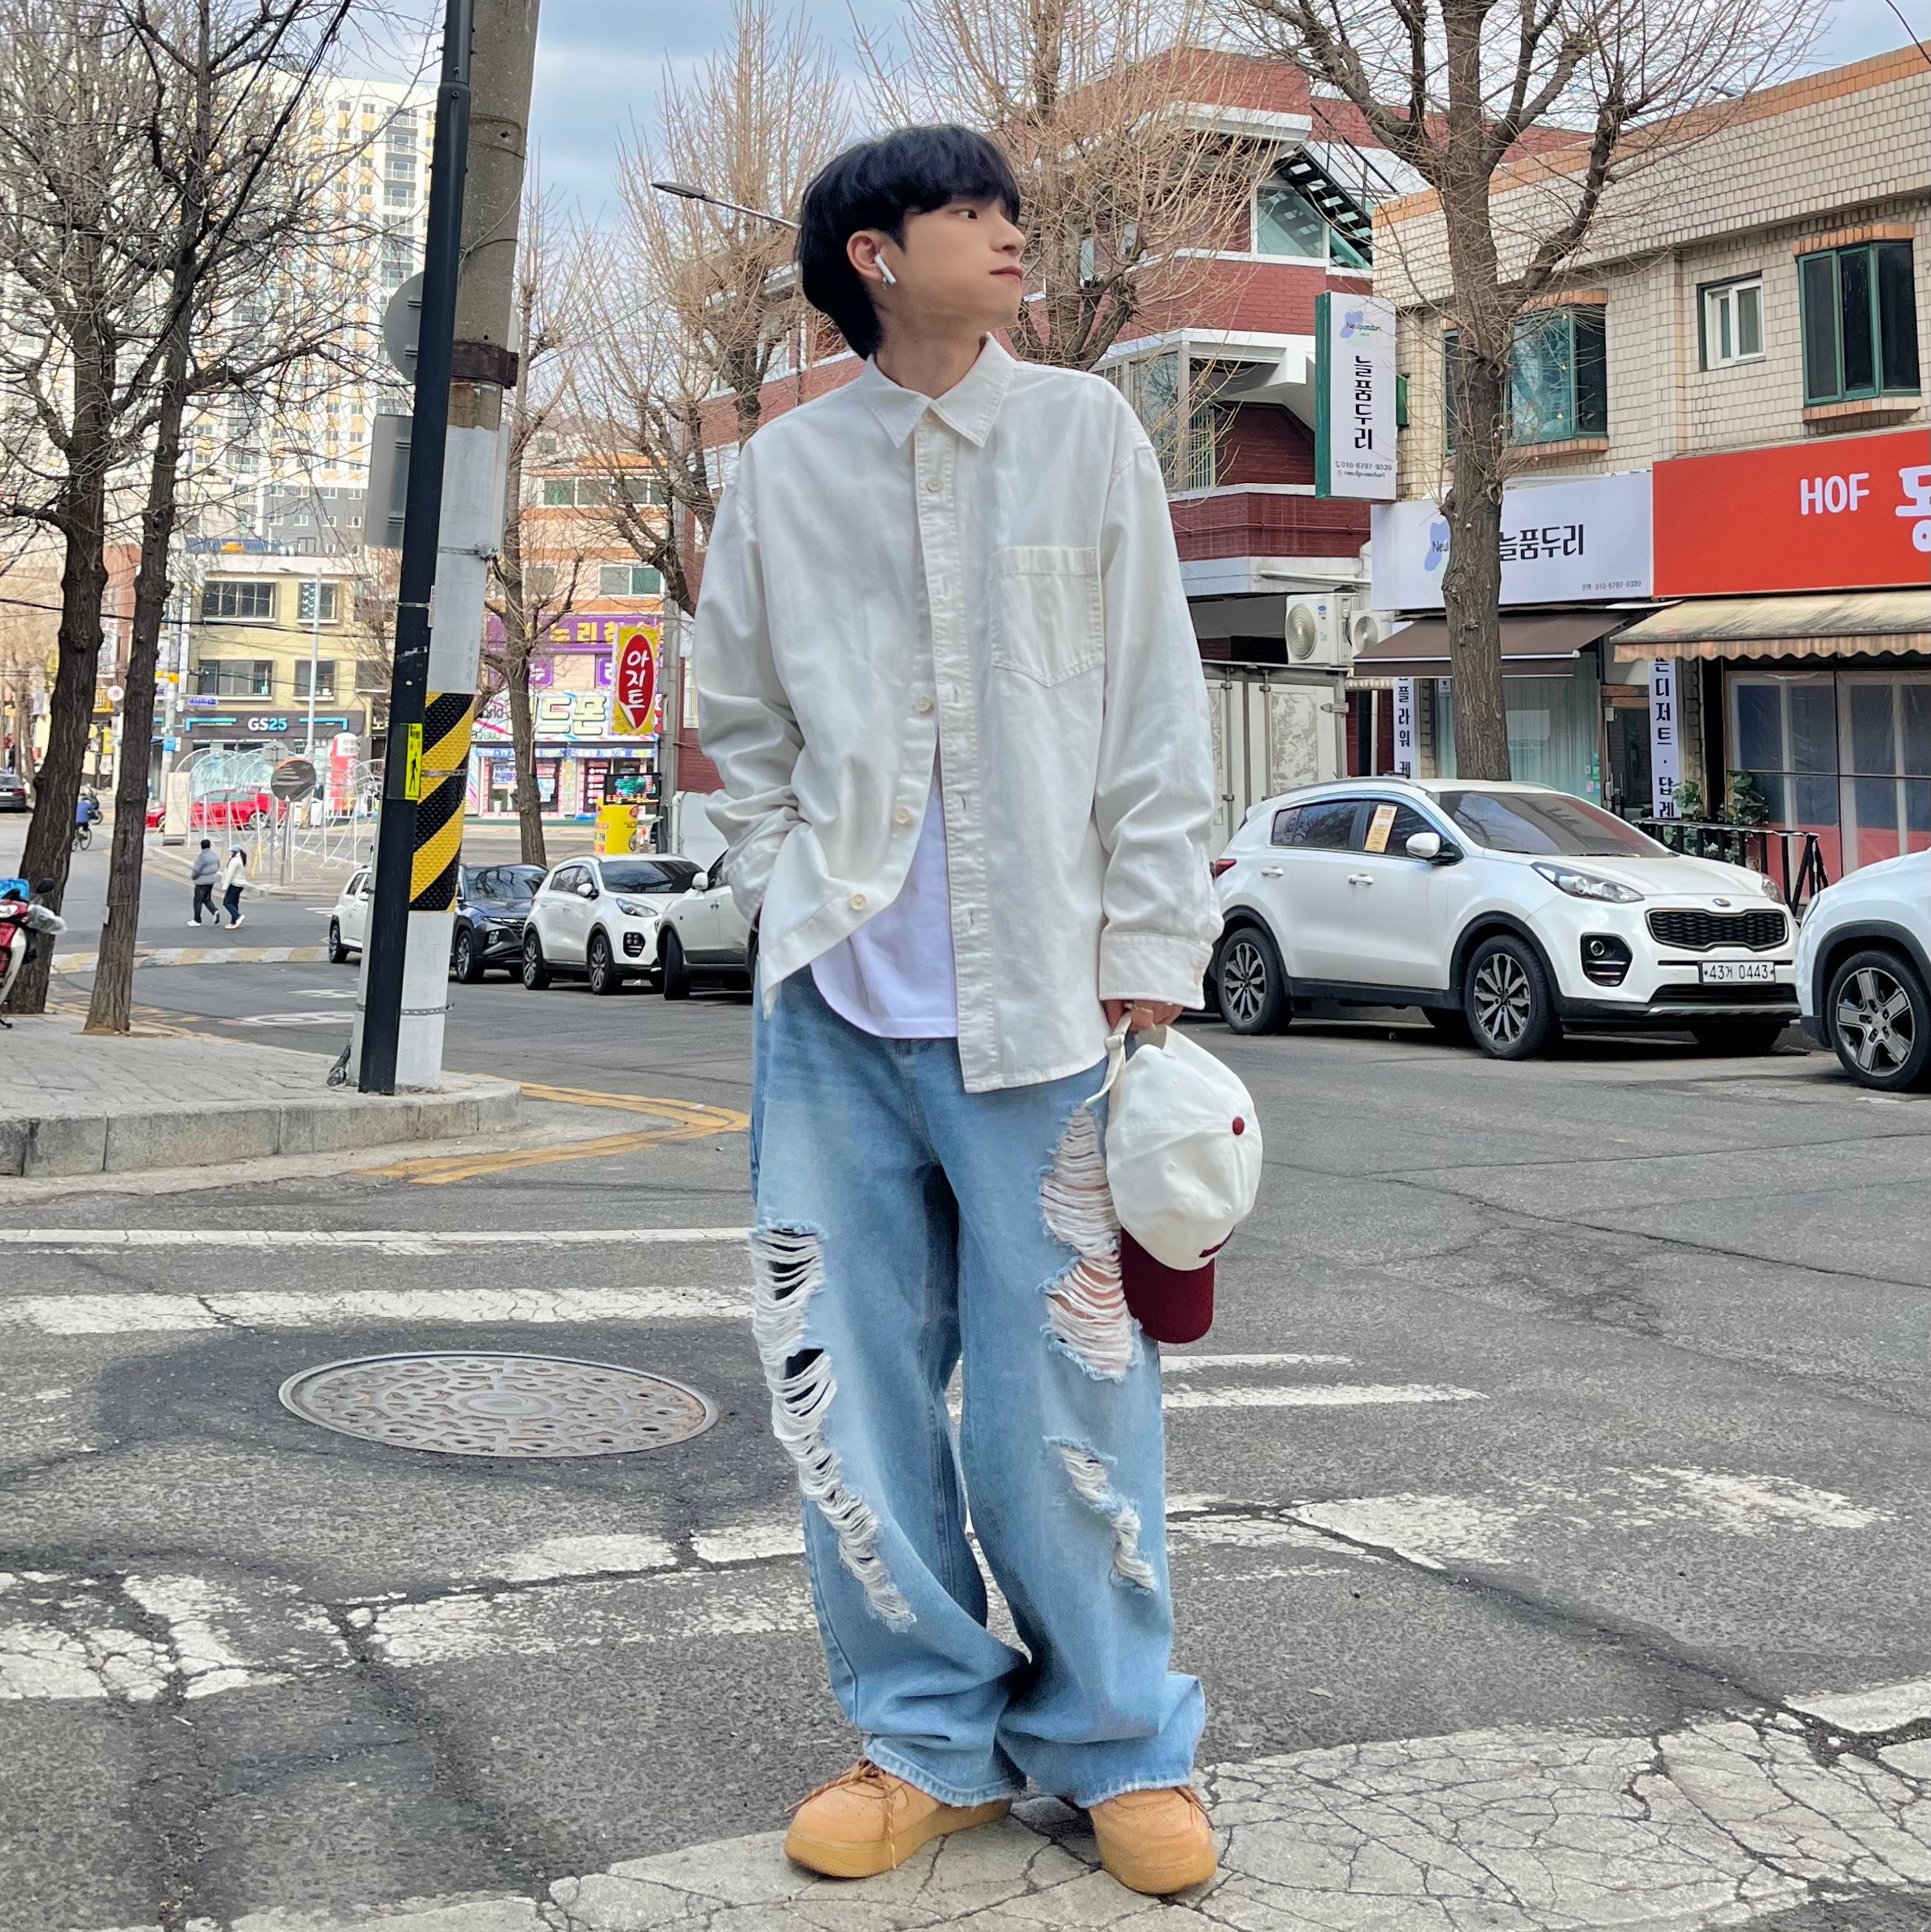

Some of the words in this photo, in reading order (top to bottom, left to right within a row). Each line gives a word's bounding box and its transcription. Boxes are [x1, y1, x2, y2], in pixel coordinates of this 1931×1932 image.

[1354, 355, 1373, 450] 늘품두리
[1800, 472, 1870, 515] HOF
[1499, 524, 1584, 561] 늘품두리
[625, 650, 650, 708] 아지트
[247, 717, 288, 731] GS25
[1397, 678, 1410, 748] 플라워
[1738, 964, 1768, 979] 0443
